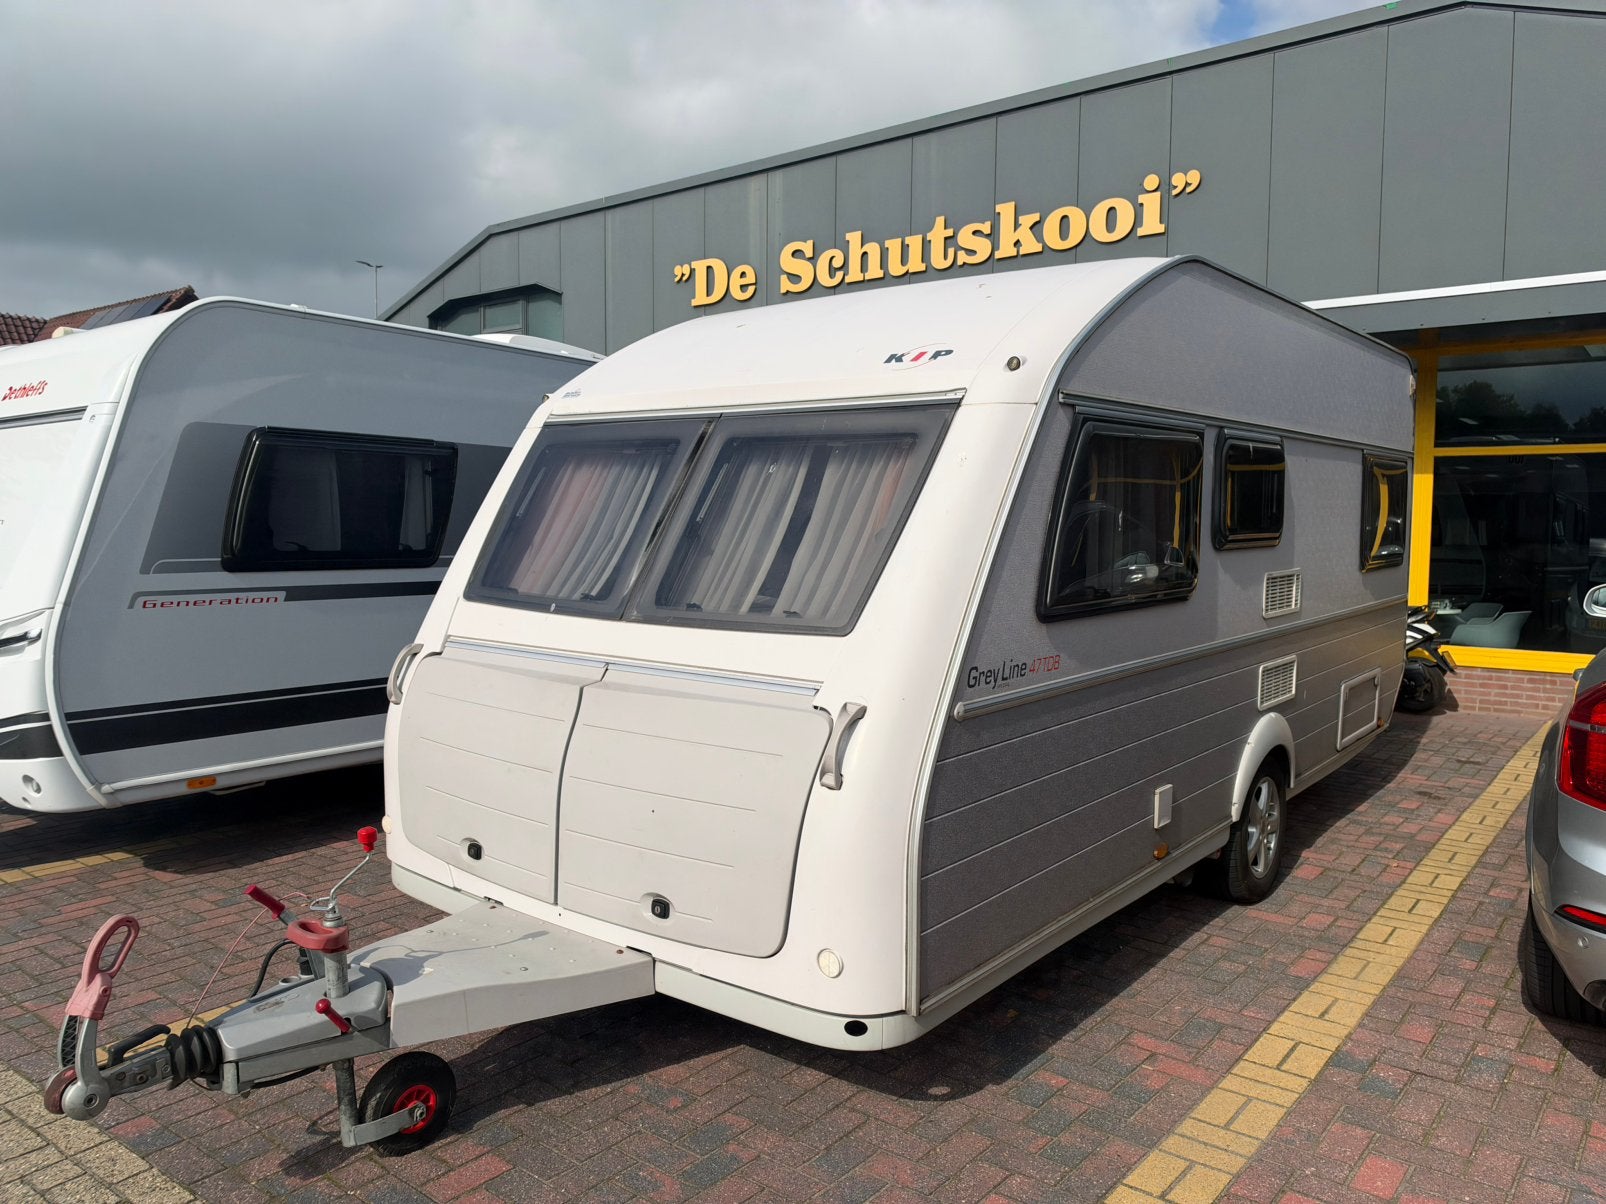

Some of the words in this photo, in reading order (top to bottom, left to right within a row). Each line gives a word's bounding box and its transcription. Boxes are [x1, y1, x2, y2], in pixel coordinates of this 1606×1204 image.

[883, 349, 954, 364] KIP
[2, 380, 48, 401] Dethleffs
[142, 596, 279, 609] Generation
[967, 665, 1000, 690] Grey
[1001, 659, 1027, 681] Line
